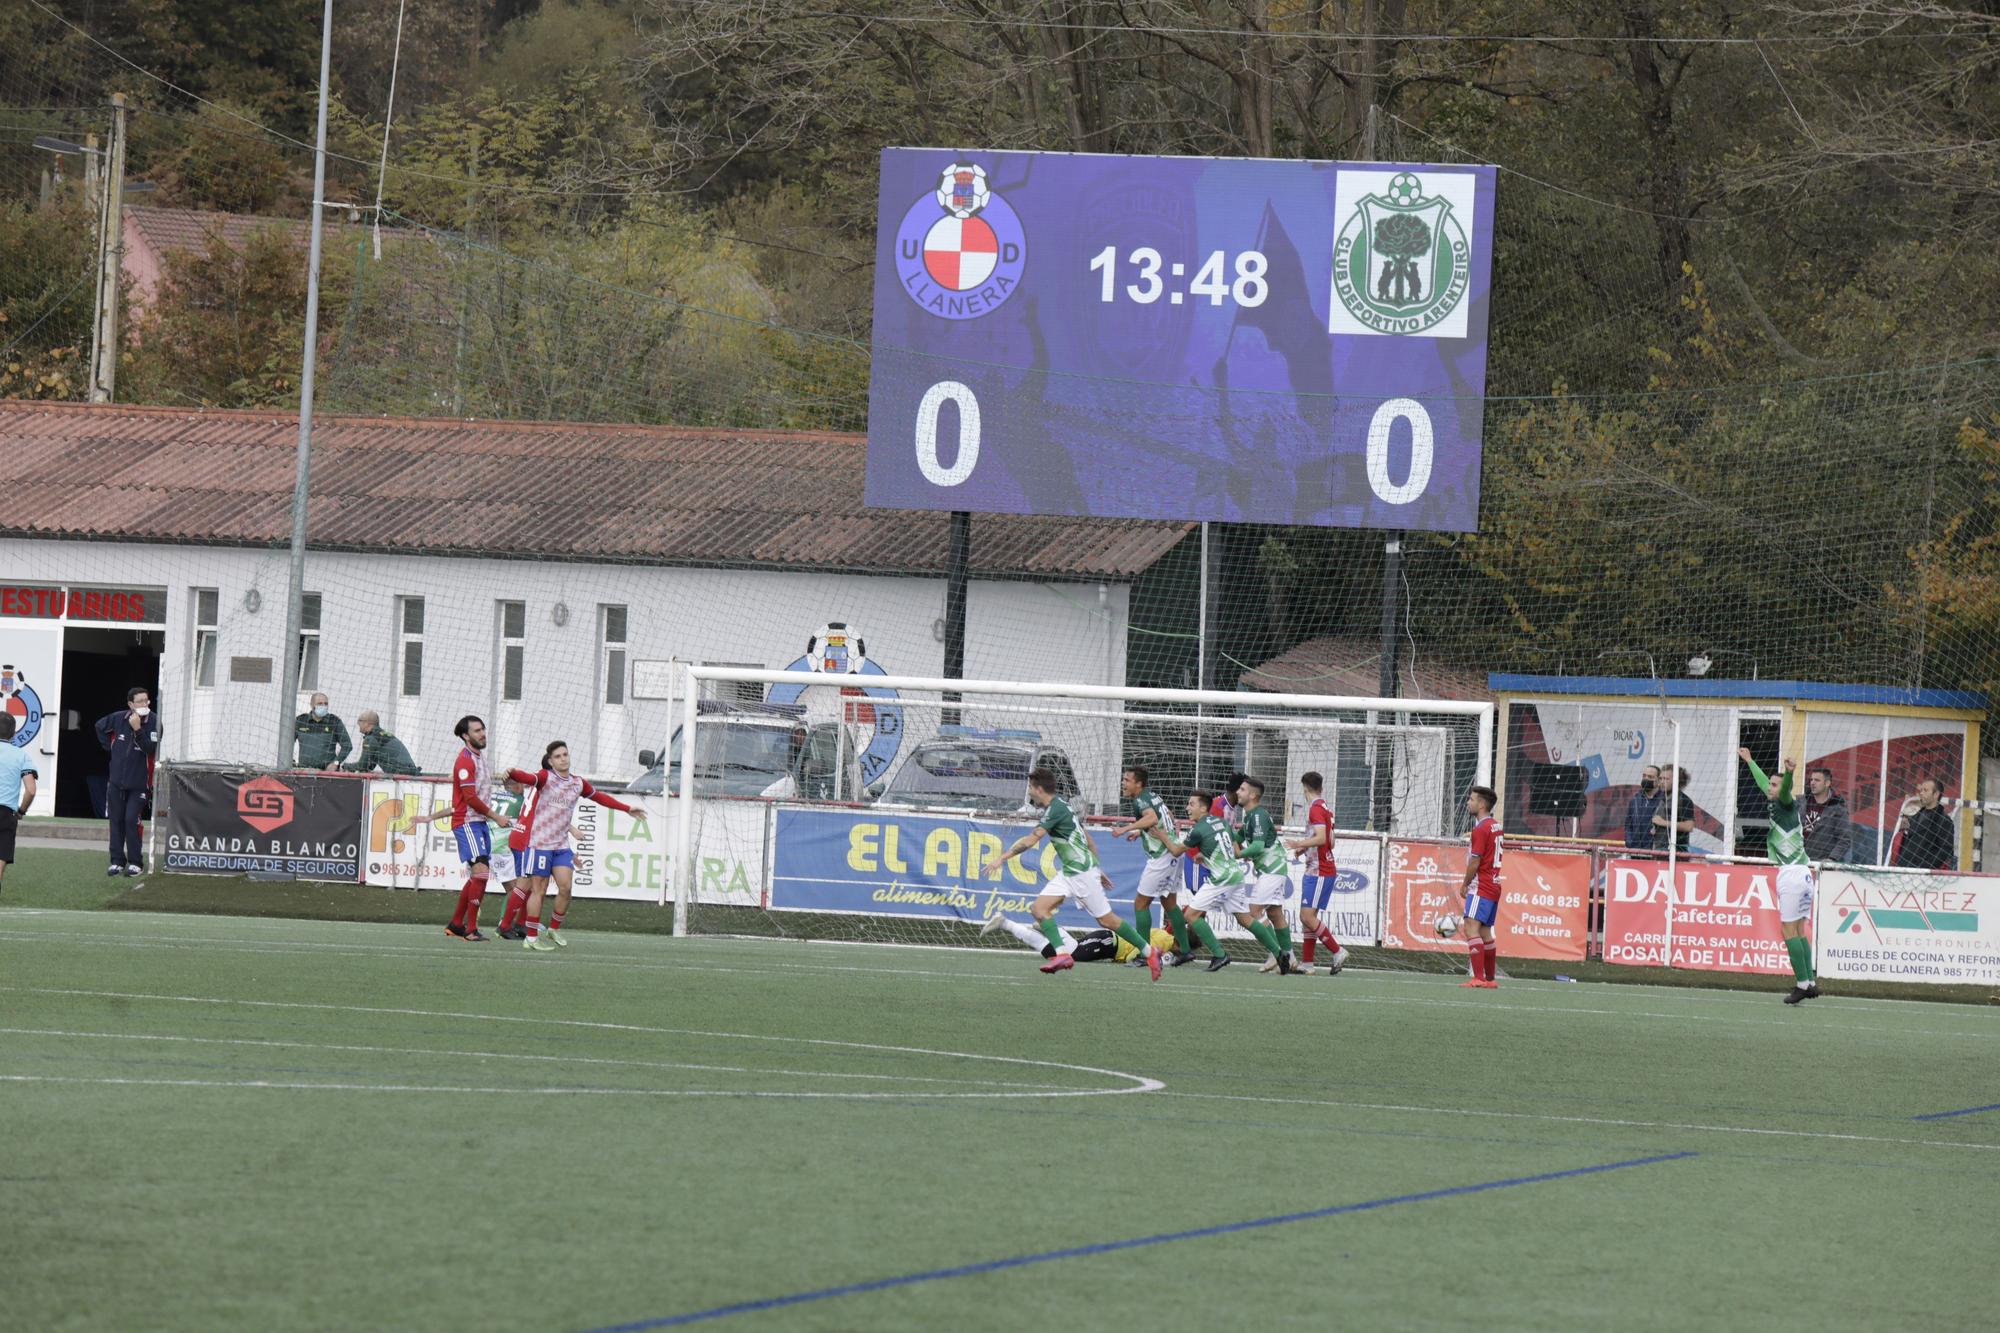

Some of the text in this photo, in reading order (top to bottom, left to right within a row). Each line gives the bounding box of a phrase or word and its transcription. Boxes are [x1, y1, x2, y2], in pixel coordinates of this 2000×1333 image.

[902, 239, 1020, 264] U D
[1090, 246, 1270, 308] 13:48
[1335, 236, 1468, 332] CLUB DEPORTIVO ARENTEIRO
[905, 271, 1015, 315] LLANERA
[914, 380, 981, 488] 0
[1366, 397, 1435, 505] 0
[0, 587, 145, 622] ESTUARIOS
[607, 806, 654, 843] LA
[168, 834, 357, 858] GRANDA BLANCO
[846, 823, 907, 874] EL
[167, 854, 356, 876] CORREDURIA DE SEGUROS
[433, 865, 446, 878] 34
[603, 852, 751, 893] SIERA
[872, 879, 977, 909] alimentos
[1420, 892, 1449, 907] Bar
[1505, 892, 1580, 908] 684 608 825
[1613, 867, 1780, 910] DALLA
[1511, 924, 1571, 938] de Llanera
[1521, 912, 1562, 925] Posada
[1710, 936, 1737, 948] SAN
[1690, 950, 1715, 965] DE
[1719, 952, 1792, 969] LLANER
[1827, 949, 1880, 960] MUEBLES
[1882, 951, 1898, 961] DE
[1901, 952, 1945, 963] COCINA
[1947, 954, 1956, 963] Y
[1837, 963, 1869, 973] LUGO
[1871, 964, 1887, 973] DE
[1890, 965, 1941, 976] LLANERA
[1943, 967, 1962, 977] 985
[1965, 969, 1978, 977] 77
[1981, 969, 1992, 979] 11
